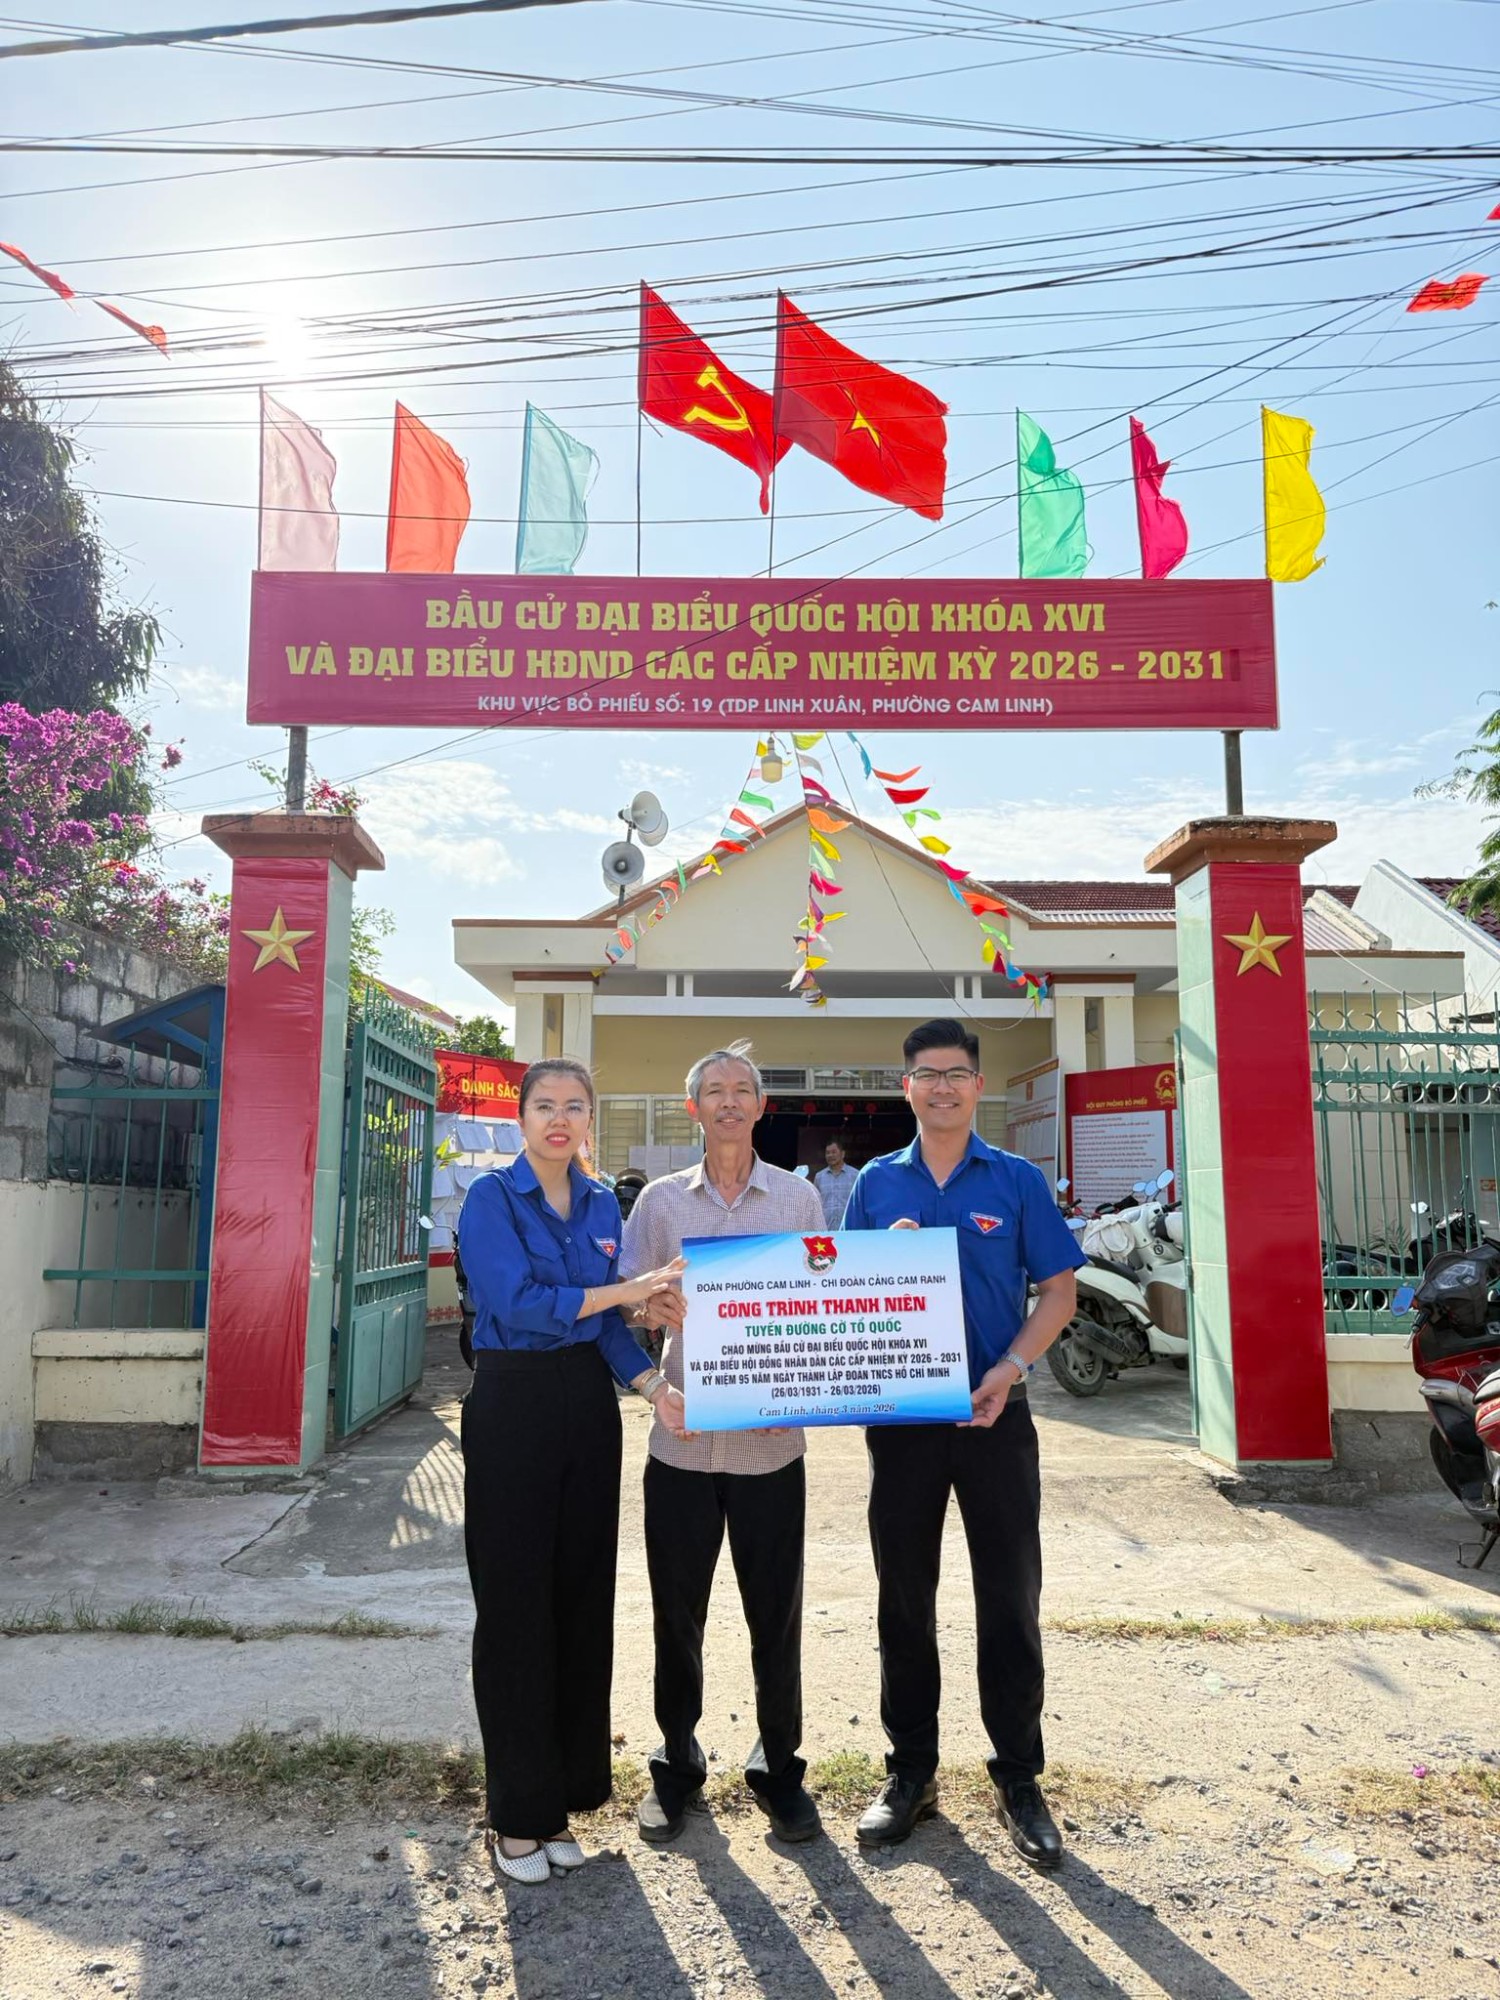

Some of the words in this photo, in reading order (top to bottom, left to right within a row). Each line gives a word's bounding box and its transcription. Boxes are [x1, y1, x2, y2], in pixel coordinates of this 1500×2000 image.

[425, 589, 503, 629] BẦU
[515, 593, 567, 630] CỬ
[576, 602, 640, 636] ĐẠI
[652, 590, 738, 632] BIỂU
[750, 593, 845, 638] QUỐC
[857, 598, 920, 637] HỘI
[931, 597, 1033, 632] KHÓA
[1043, 603, 1105, 632] XVI
[285, 640, 337, 675] VÀ
[348, 647, 414, 681] ĐẠI
[426, 636, 515, 678] BIỂU
[526, 650, 634, 679] HĐND
[646, 645, 714, 680] CÁC
[726, 641, 798, 680] CẤP
[808, 645, 937, 686] NHIỆM
[948, 645, 997, 680] KỲ
[1010, 651, 1100, 680] 2026
[1138, 651, 1224, 680] 2031
[478, 696, 516, 711] KHU
[521, 694, 561, 715] VỰC
[567, 692, 593, 712] BỎ
[599, 692, 650, 713] PHIẾU
[655, 692, 685, 713] SỐ:
[692, 699, 713, 713] 19
[718, 698, 759, 717] (TDP
[764, 698, 804, 713] LINH
[810, 694, 867, 716] XUÂN,
[872, 694, 951, 713] PHƯỜNG
[956, 698, 999, 713] CAM
[1005, 698, 1054, 717] LINH)
[461, 1078, 495, 1097] DANH
[497, 1081, 520, 1100] SÁC
[697, 1281, 723, 1293] ĐOÀN
[767, 1280, 787, 1290] CAM
[789, 1279, 811, 1289] LINH
[821, 1278, 838, 1288] CHI
[840, 1275, 866, 1288] ĐOÀN
[897, 1275, 918, 1285] CAM
[920, 1275, 946, 1284] RANH
[718, 1299, 762, 1319] CÔNG
[766, 1297, 818, 1317] TRÌNH
[822, 1297, 880, 1315] THANH
[884, 1293, 926, 1313] NIÊN
[745, 1320, 782, 1337] TUYẾN
[869, 1316, 902, 1334] QUỐC
[871, 1337, 886, 1350] HỘI
[913, 1338, 928, 1349] XVI
[703, 1361, 718, 1373] ĐẠI
[741, 1356, 757, 1371] HỘI
[910, 1353, 932, 1363] 2026
[940, 1352, 961, 1363] 2031
[738, 1373, 750, 1385] 95
[871, 1367, 893, 1380] TNCS
[927, 1367, 950, 1377] MINH
[771, 1386, 822, 1399] (26/03/1931
[830, 1384, 882, 1397] 26/03/2026)
[759, 1407, 781, 1417] Cam
[842, 1405, 848, 1413] 3
[873, 1403, 896, 1413] 2026
